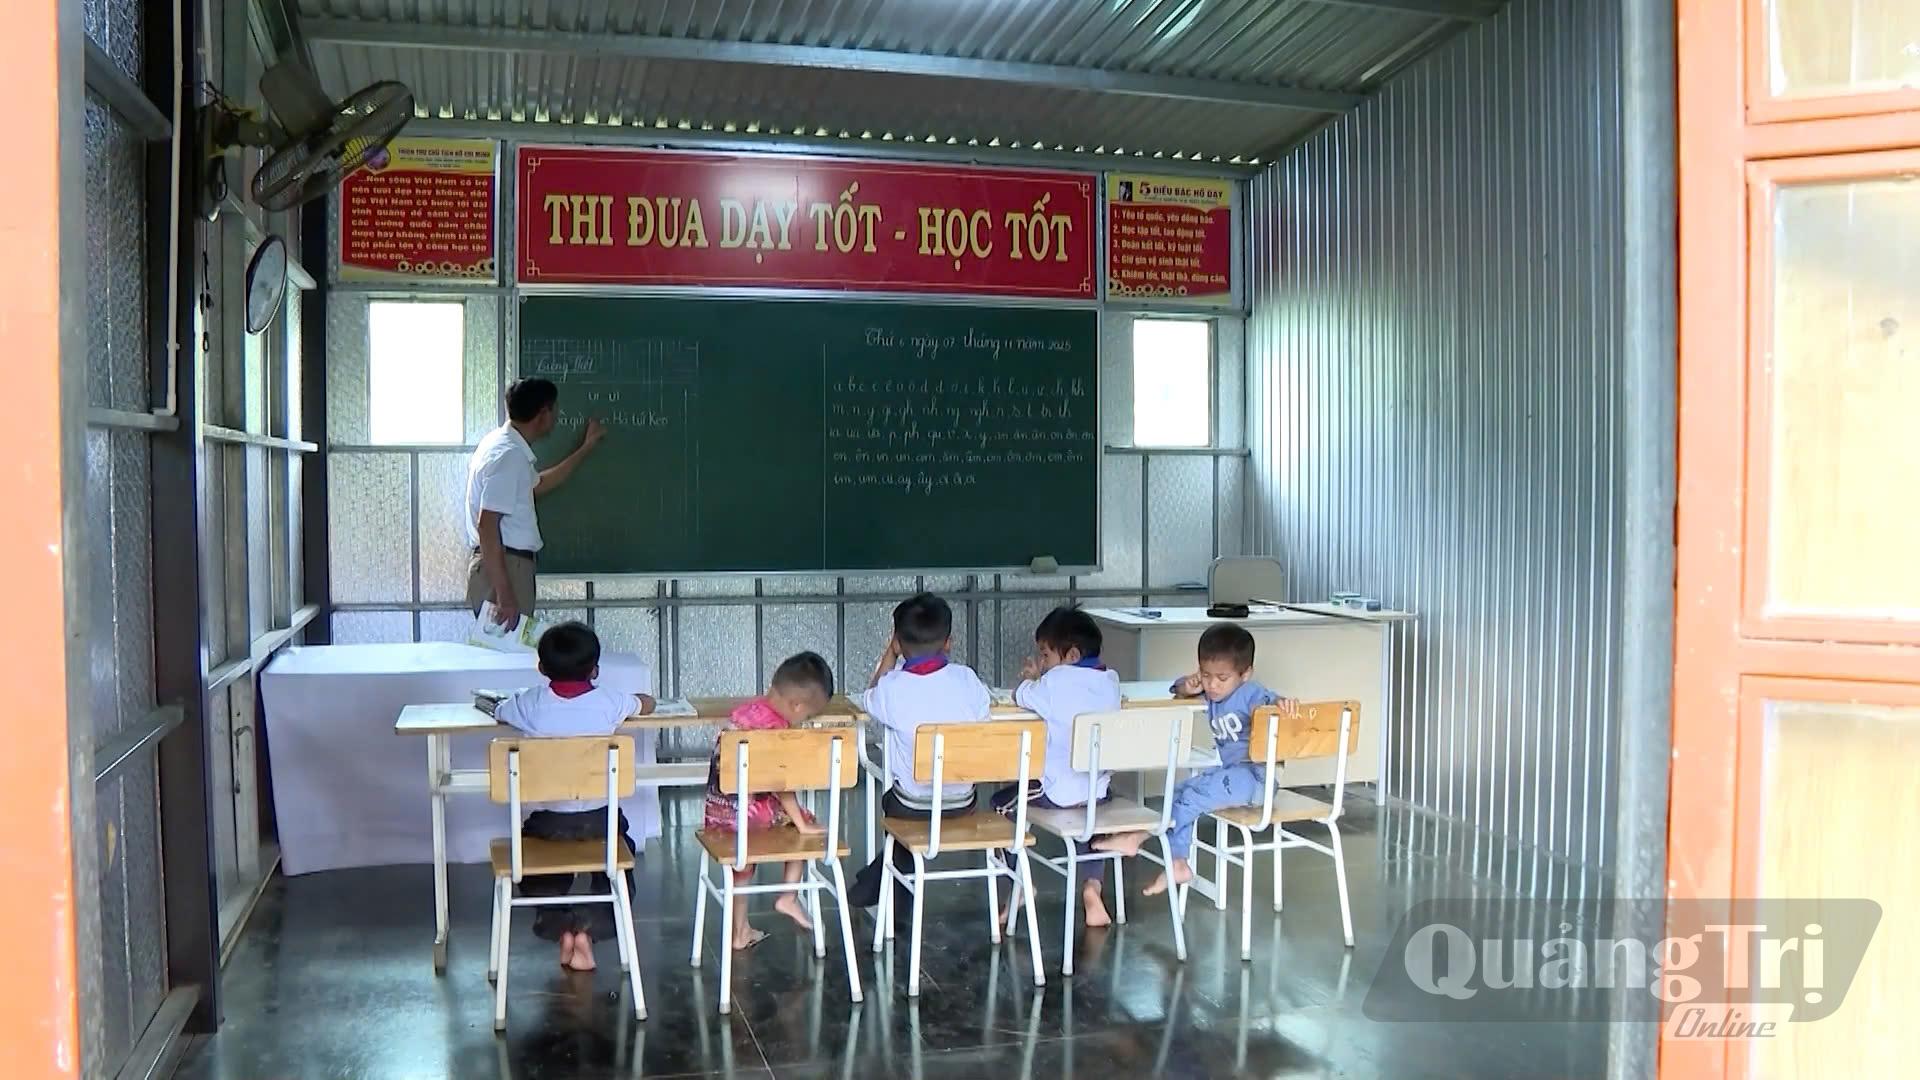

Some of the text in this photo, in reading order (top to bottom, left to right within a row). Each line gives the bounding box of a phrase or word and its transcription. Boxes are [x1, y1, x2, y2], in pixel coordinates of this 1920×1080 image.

[414, 176, 432, 186] Việt
[435, 177, 457, 186] Nam
[415, 188, 432, 197] hay
[1139, 181, 1151, 196] 5
[370, 197, 387, 206] Việt
[391, 197, 413, 206] Nam
[352, 207, 372, 215] vinh
[376, 209, 406, 218] quang
[454, 210, 468, 218] vai
[1114, 209, 1121, 219] 1.
[1121, 209, 1135, 219] Yêu
[1167, 213, 1180, 222] yêu
[544, 181, 1073, 272] THI ĐUA DẠY TỐT - HỌC TỐT
[1113, 223, 1120, 233] 2.
[1121, 225, 1136, 235] Học
[377, 230, 394, 239] hay
[1113, 239, 1120, 249] 3.
[1158, 257, 1174, 266] sinh
[864, 327, 894, 347] Thứ
[911, 333, 938, 360] ngày
[964, 327, 1000, 360] tháng
[1016, 335, 1044, 350] năm
